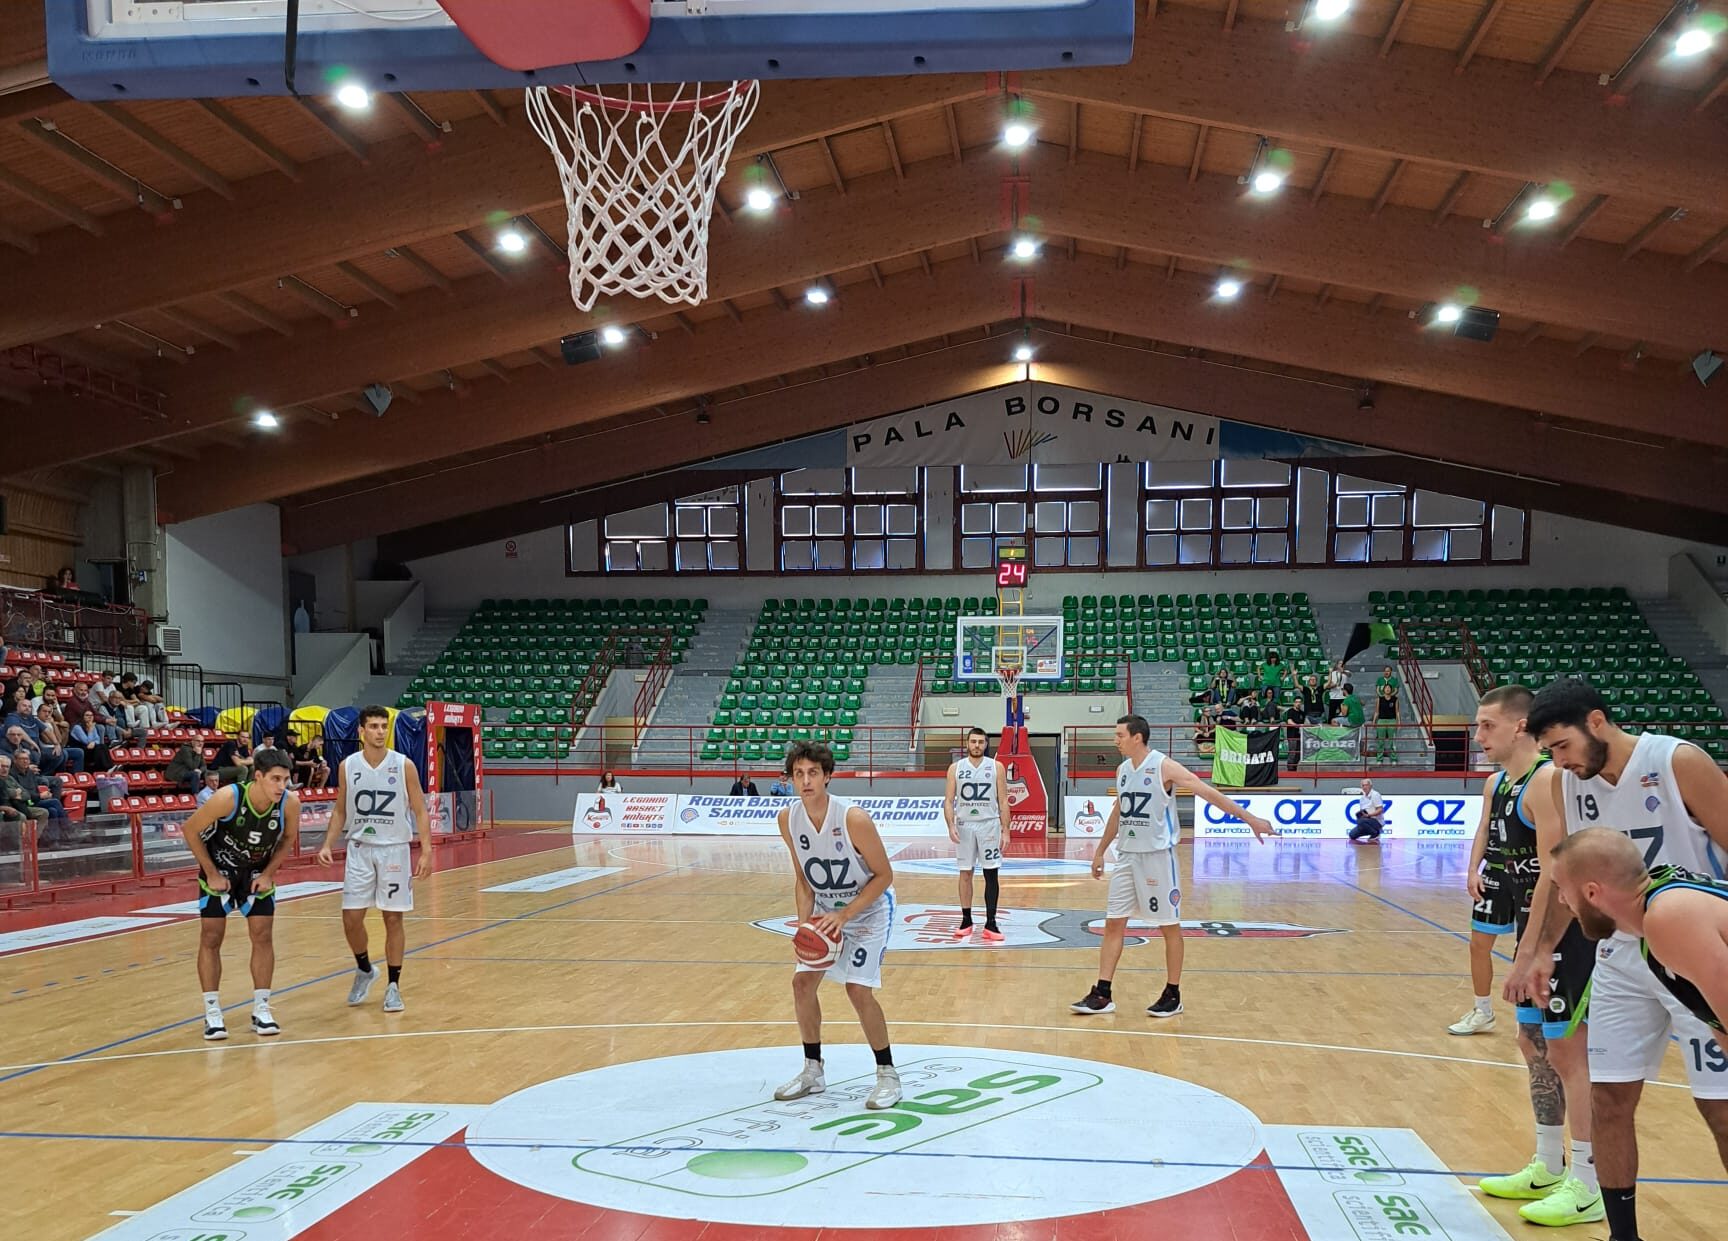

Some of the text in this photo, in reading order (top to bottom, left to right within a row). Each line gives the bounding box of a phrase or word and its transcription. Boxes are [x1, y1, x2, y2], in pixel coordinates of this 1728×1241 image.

[852, 396, 1215, 453] PALA BORSANI
[998, 563, 1025, 584] 24
[1304, 738, 1356, 749] faenza
[1220, 749, 1274, 765] BRIGATA
[353, 772, 362, 785] 7
[958, 770, 972, 780] 22
[1120, 775, 1127, 787] 8
[688, 796, 800, 808] ROBUR BASK
[853, 799, 956, 809] BUR BASK
[1576, 794, 1600, 821] 19
[708, 808, 779, 819] SARONN
[868, 810, 939, 820] ARONNO
[1009, 820, 1044, 833] GHTS
[247, 831, 262, 844] 5
[800, 834, 810, 850] 9
[985, 848, 1000, 860] 22
[388, 884, 400, 899] 7
[1149, 896, 1159, 912] 8
[1474, 898, 1493, 914] 21
[852, 947, 867, 967] 9
[809, 1069, 1062, 1141] sae
[371, 1112, 436, 1140] sae
[1333, 1135, 1379, 1167] sae
[266, 1163, 348, 1201] sae
[1374, 1194, 1432, 1236] sae
